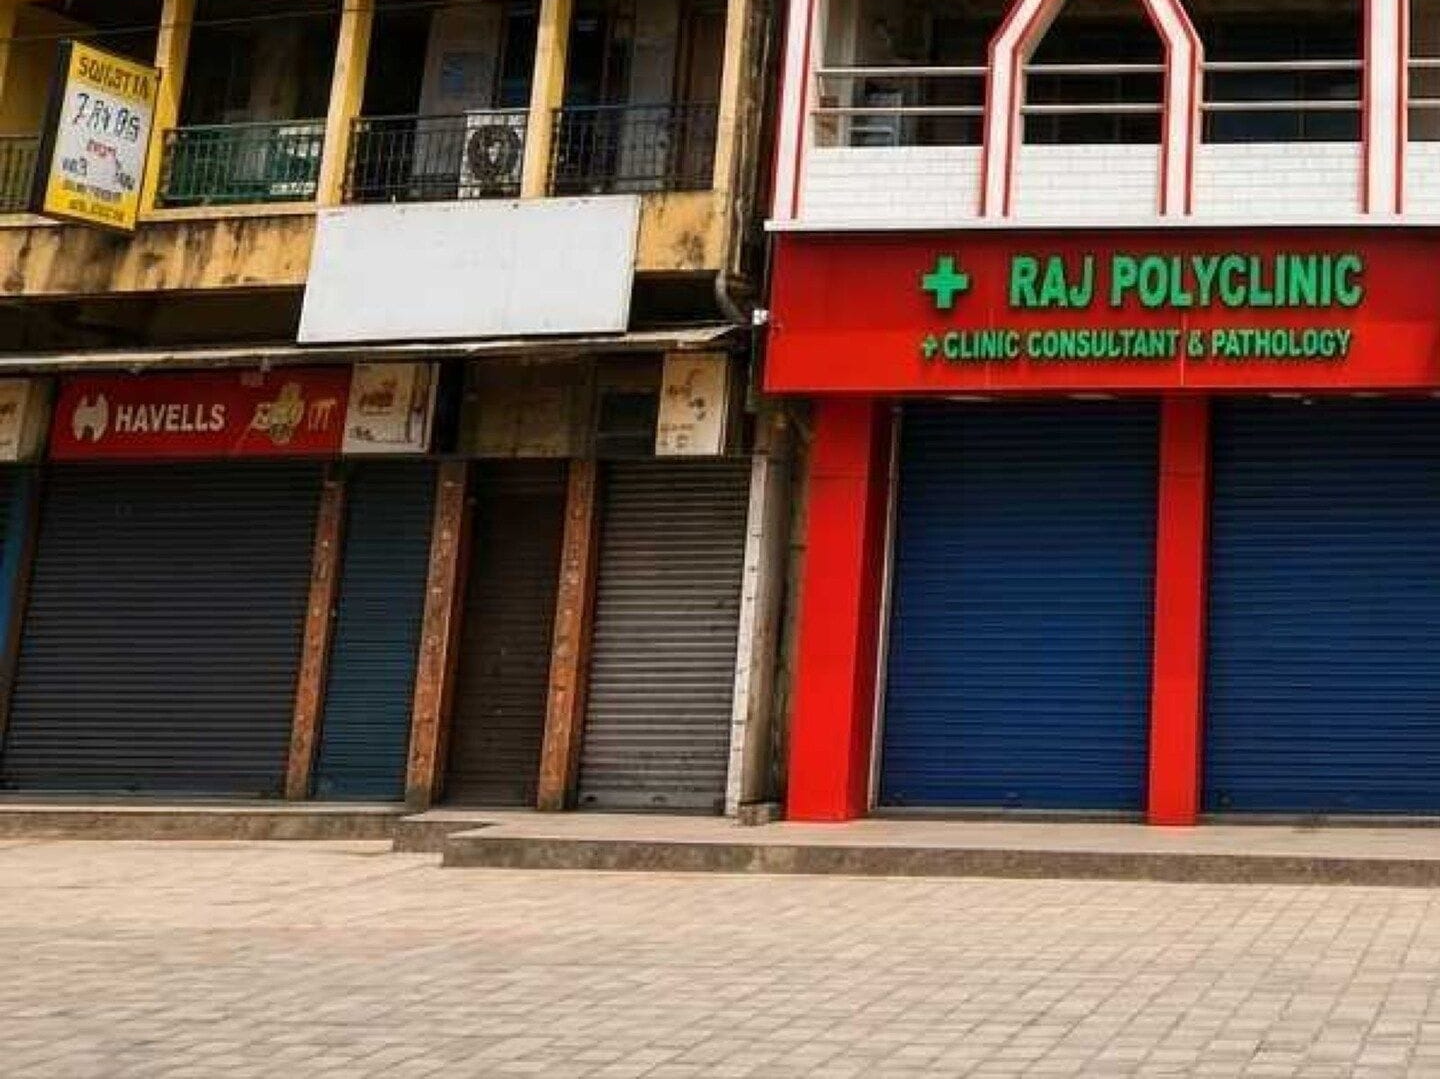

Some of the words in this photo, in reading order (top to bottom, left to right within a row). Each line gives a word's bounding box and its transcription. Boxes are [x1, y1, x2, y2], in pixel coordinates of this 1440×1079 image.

[1009, 253, 1095, 307] RAJ
[1110, 253, 1364, 307] POLYCLINIC
[943, 329, 1020, 360] CLINIC
[1026, 328, 1180, 359] CONSULTANT
[1187, 328, 1204, 358] &
[1210, 327, 1351, 359] PATHOLOGY
[114, 403, 226, 433] HAVELLS
